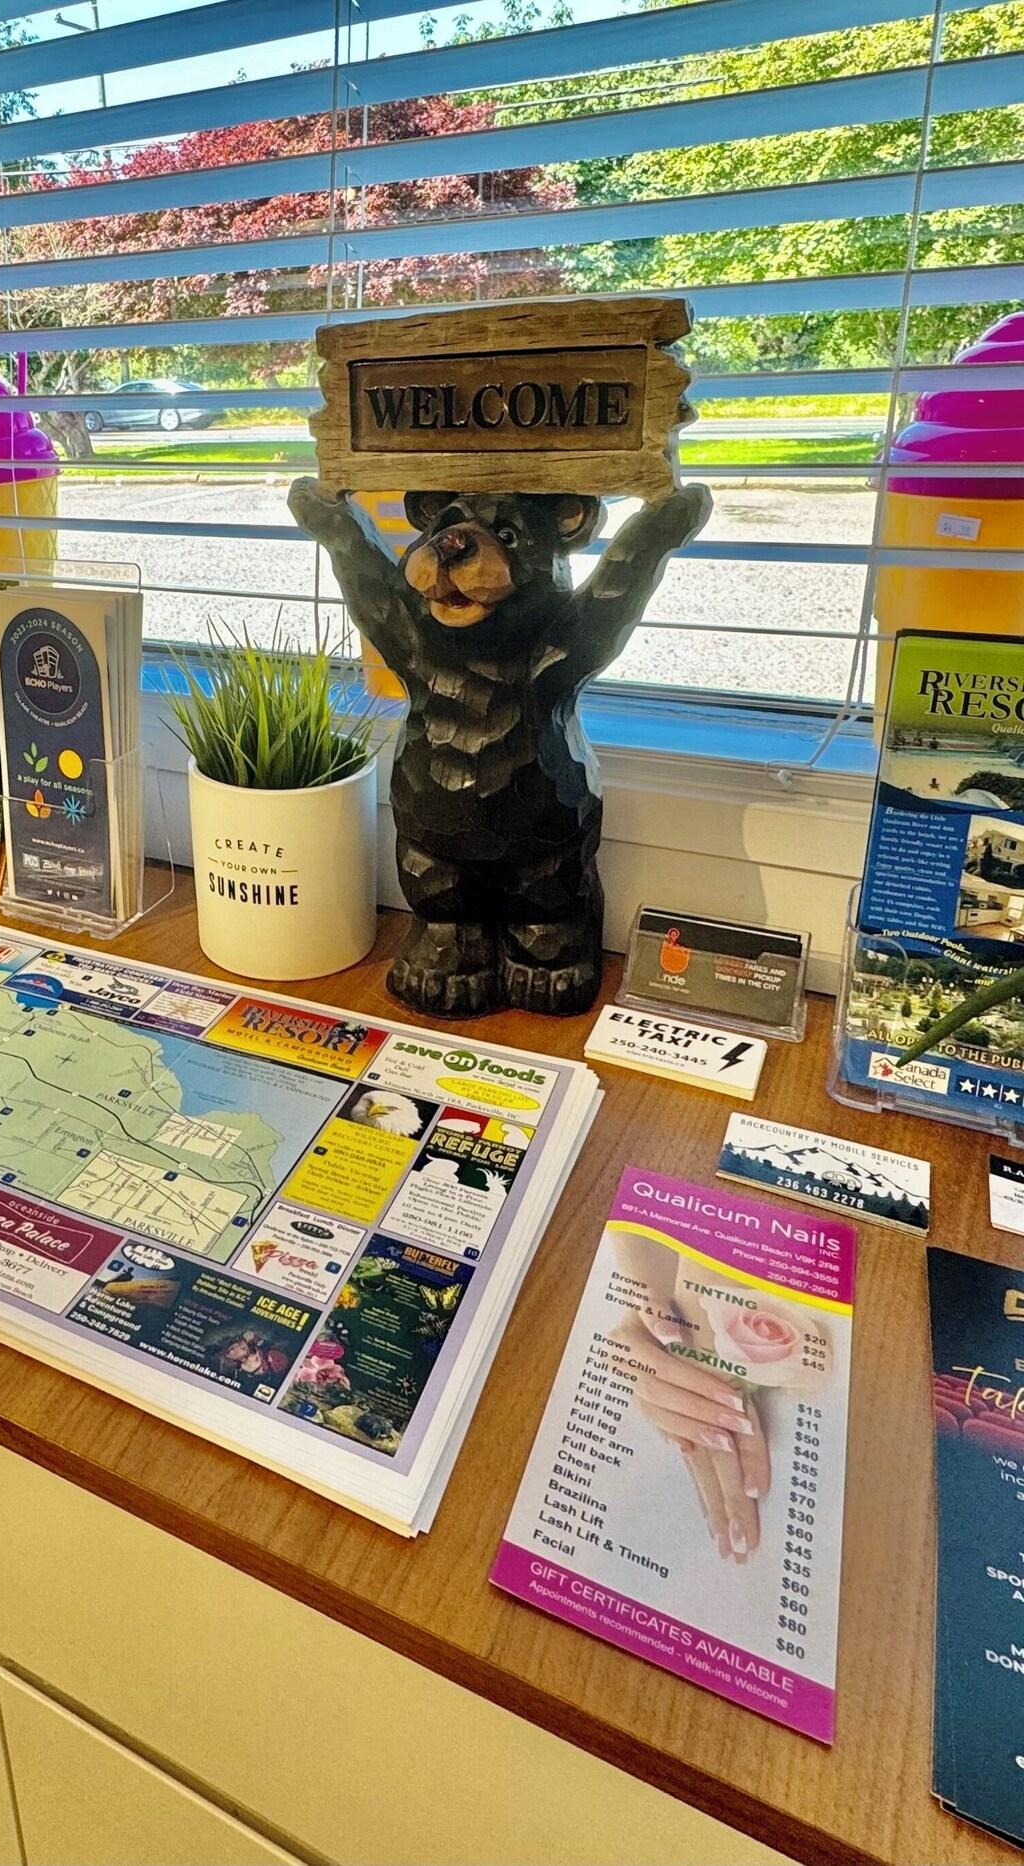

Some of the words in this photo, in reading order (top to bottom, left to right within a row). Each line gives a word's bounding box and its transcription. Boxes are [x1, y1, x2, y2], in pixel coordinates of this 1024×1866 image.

[364, 382, 631, 430] WELCOME
[51, 621, 84, 653] SEASON
[25, 677, 47, 688] ECHO
[47, 681, 73, 692] Players
[24, 776, 39, 787] play
[41, 778, 51, 787] for
[53, 782, 62, 790] all
[215, 839, 284, 858] CREATE
[221, 860, 246, 872] YOUR
[251, 866, 277, 875] OWN
[209, 872, 298, 906] SUNSHINE
[882, 929, 899, 937] Two
[902, 930, 940, 943] Outdoor
[943, 950, 972, 966] Giant
[714, 973, 737, 985] TIMES
[747, 980, 762, 988] THE
[763, 982, 781, 992] CITY
[754, 973, 782, 983] PICKUP
[769, 968, 787, 977] AND
[88, 987, 141, 1005] Jayco
[242, 1014, 361, 1056] RESORT
[609, 1013, 728, 1046] ELECTRIC
[637, 1028, 693, 1048] TAXI
[227, 1028, 260, 1041] MOTEL
[276, 1041, 353, 1065] CAMPGROUND
[609, 1036, 708, 1066] 250-240-3445
[867, 1030, 892, 1043] ALL
[938, 1044, 956, 1056] TO
[959, 1049, 987, 1062] THE
[393, 1041, 443, 1061] save
[445, 1053, 473, 1067] on
[479, 1060, 546, 1085] foods
[894, 1071, 936, 1090] Select
[95, 1091, 157, 1118] PARKSVILLE
[429, 1133, 520, 1167] REFUGE
[740, 1118, 810, 1142] BACKCOUNTRY
[814, 1137, 826, 1146] RV
[831, 1141, 866, 1157] MOBILE
[871, 1151, 919, 1171] SERVICES
[777, 1176, 799, 1190] 236
[805, 1184, 827, 1198] 463
[833, 1191, 864, 1209] 2278
[9, 1199, 60, 1225] oceanside
[633, 1182, 761, 1230] Qualicum
[771, 1220, 841, 1251] Nails
[649, 1211, 691, 1229] Memorial
[15, 1221, 70, 1251] Palace
[123, 1216, 196, 1248] PARKSVILLE
[716, 1232, 759, 1249] Qualicum
[761, 1245, 792, 1258] Beach
[733, 1249, 764, 1263] Phone:
[26, 1254, 70, 1277] Delivery
[402, 1246, 460, 1271] BUTTERFLY
[608, 1282, 650, 1302] Lashes
[611, 1271, 648, 1290] Brows
[84, 1295, 132, 1319] Adventures
[90, 1288, 115, 1301] Horne
[116, 1297, 136, 1311] Lake
[256, 1296, 275, 1310] ICE
[683, 1280, 758, 1311] TINTING
[87, 1303, 142, 1332] Campground
[250, 1305, 297, 1329] ADVENTURES
[605, 1292, 642, 1313] Brows
[645, 1307, 654, 1315] &
[657, 1310, 701, 1331] Lashes
[593, 1333, 631, 1353] Brows
[804, 1333, 826, 1346] $20
[139, 1340, 241, 1389] www.hornelake.com
[589, 1344, 609, 1360] Lip
[611, 1354, 625, 1364] or
[628, 1359, 657, 1376] Chin
[667, 1341, 748, 1377] WAXING
[803, 1346, 826, 1359] $25
[586, 1357, 609, 1373] Full
[612, 1366, 638, 1383] face
[802, 1358, 825, 1372] $45
[578, 1381, 602, 1400] Full
[606, 1394, 629, 1408] arm
[582, 1369, 608, 1387] Half
[611, 1381, 634, 1396] arm
[573, 1394, 599, 1413] Half
[602, 1406, 623, 1422] leg
[798, 1403, 823, 1419] $15
[570, 1408, 594, 1426] Full
[597, 1419, 618, 1436] leg
[796, 1417, 820, 1433] $11
[566, 1421, 606, 1446] Under
[608, 1439, 634, 1457] arm
[795, 1431, 820, 1447] $50
[557, 1449, 597, 1474] Chest
[561, 1435, 586, 1454] Full
[590, 1447, 622, 1468] back
[793, 1445, 819, 1462] $40
[552, 1463, 592, 1488] Bikini
[792, 1461, 819, 1477] $55
[548, 1478, 608, 1512] Brazilina
[791, 1475, 817, 1493] $45
[544, 1494, 577, 1517] Lash
[580, 1510, 605, 1530] Lift
[789, 1491, 816, 1509] $70
[788, 1507, 815, 1525] $30
[532, 1528, 575, 1557] Facial
[538, 1510, 573, 1534] Lash
[576, 1526, 600, 1547] Lift
[603, 1539, 615, 1552] &
[619, 1544, 671, 1578] Tinting
[786, 1524, 813, 1543] $60
[784, 1540, 812, 1561] $45
[783, 1558, 812, 1579] $35
[782, 1576, 810, 1597] $60
[779, 1594, 808, 1616] $60
[530, 1561, 569, 1587] GIFT
[570, 1580, 693, 1646] CERTIFICATES
[695, 1639, 795, 1694] AVAILABLE
[777, 1614, 807, 1637] $80
[529, 1580, 598, 1620] Appointments
[599, 1613, 675, 1656] recommended
[684, 1654, 732, 1684] Walk-ins
[735, 1675, 789, 1708] Welcome
[775, 1637, 806, 1660] $80
